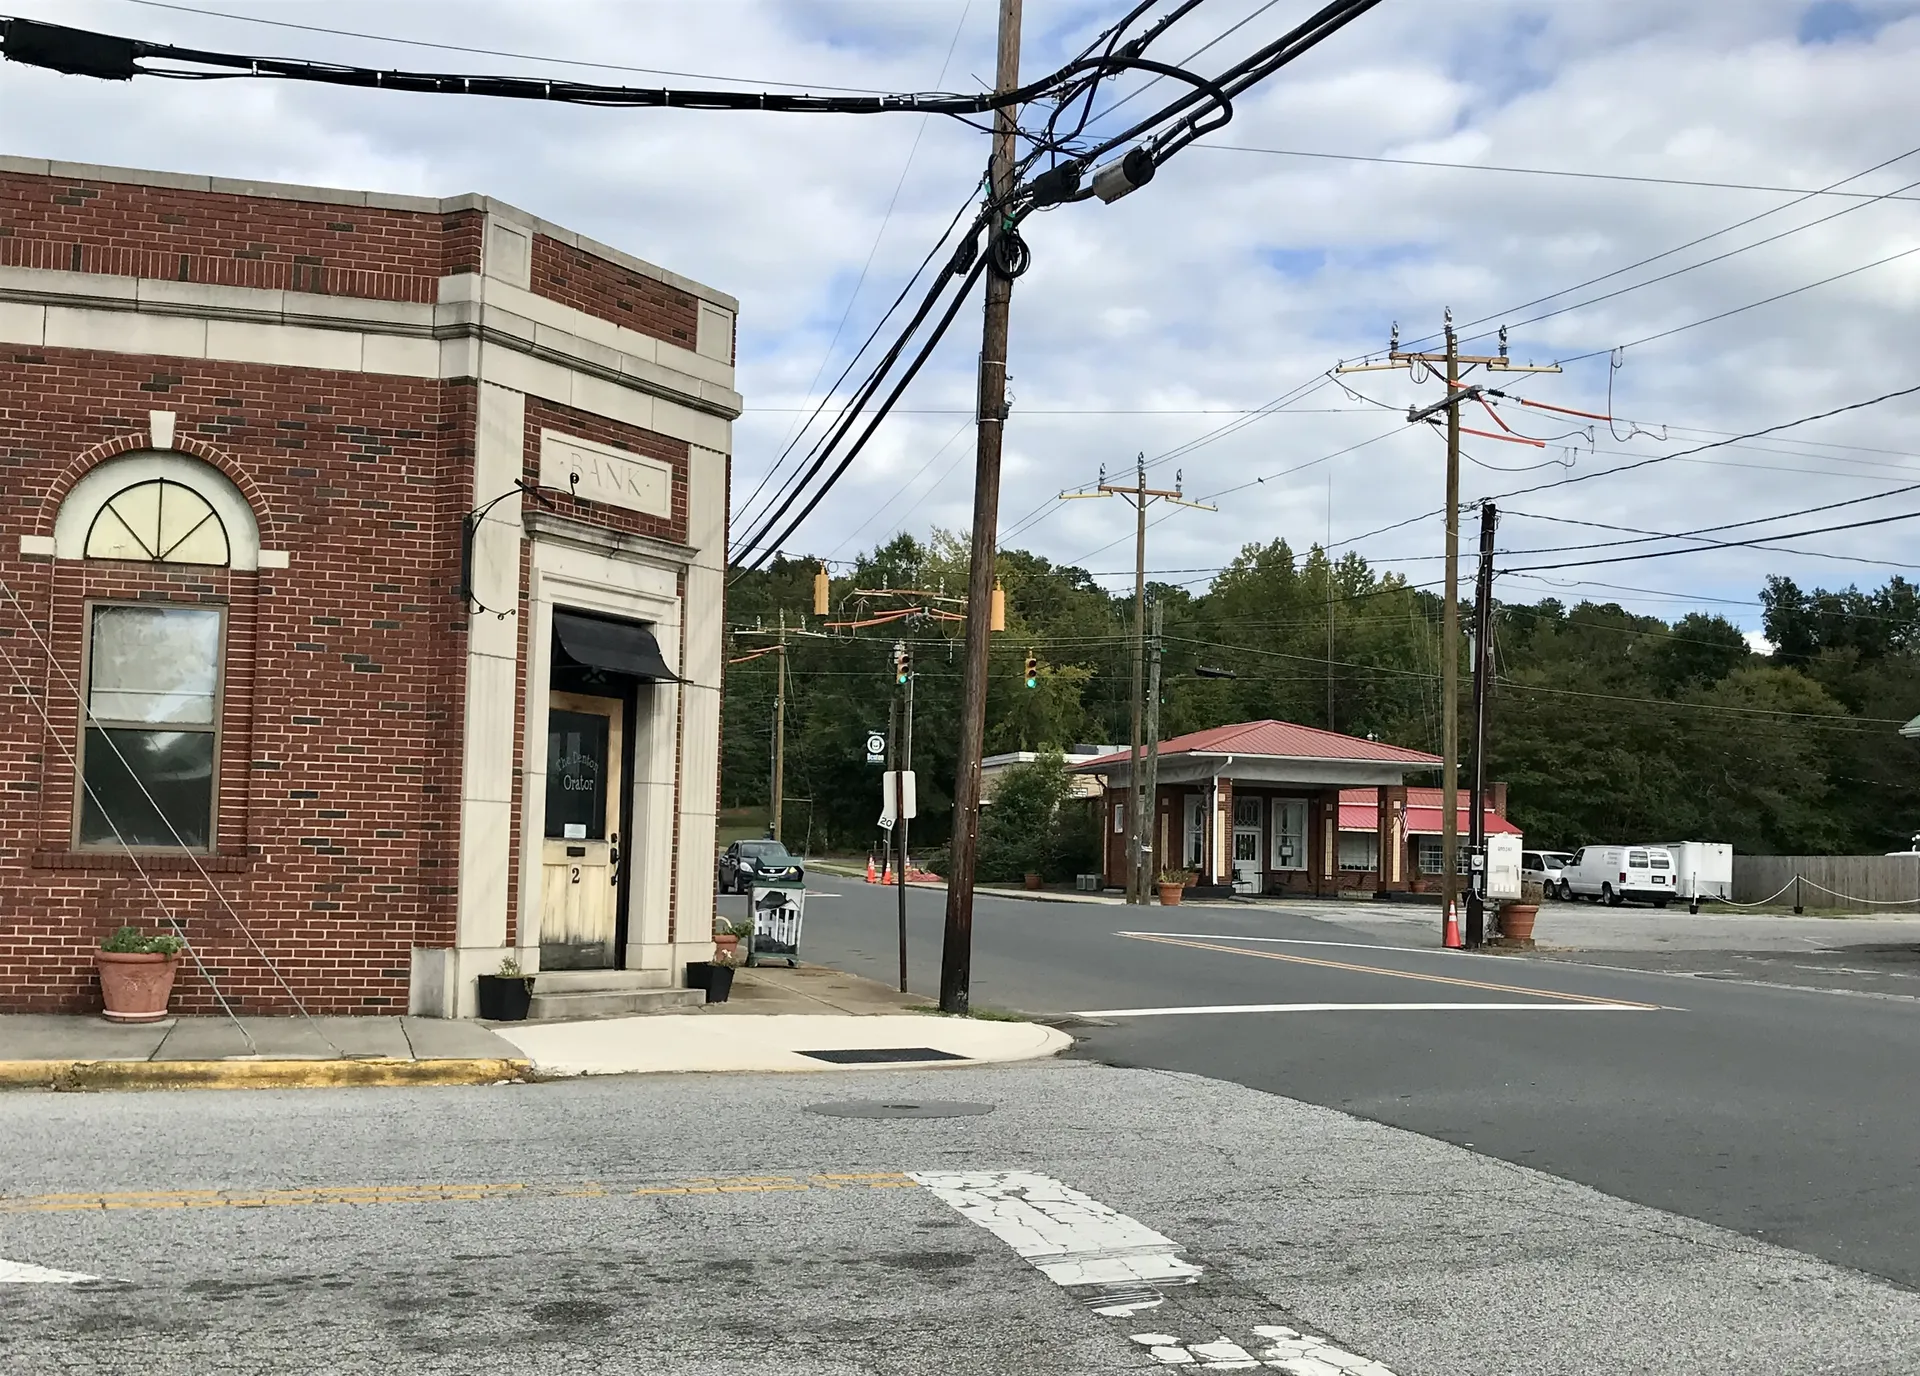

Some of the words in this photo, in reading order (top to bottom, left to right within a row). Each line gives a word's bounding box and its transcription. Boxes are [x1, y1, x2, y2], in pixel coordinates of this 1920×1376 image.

[571, 453, 641, 497] BANK
[555, 757, 571, 771] The
[572, 751, 598, 773] Denton
[563, 774, 594, 791] Orator
[880, 816, 893, 828] 20
[571, 867, 580, 884] 2
